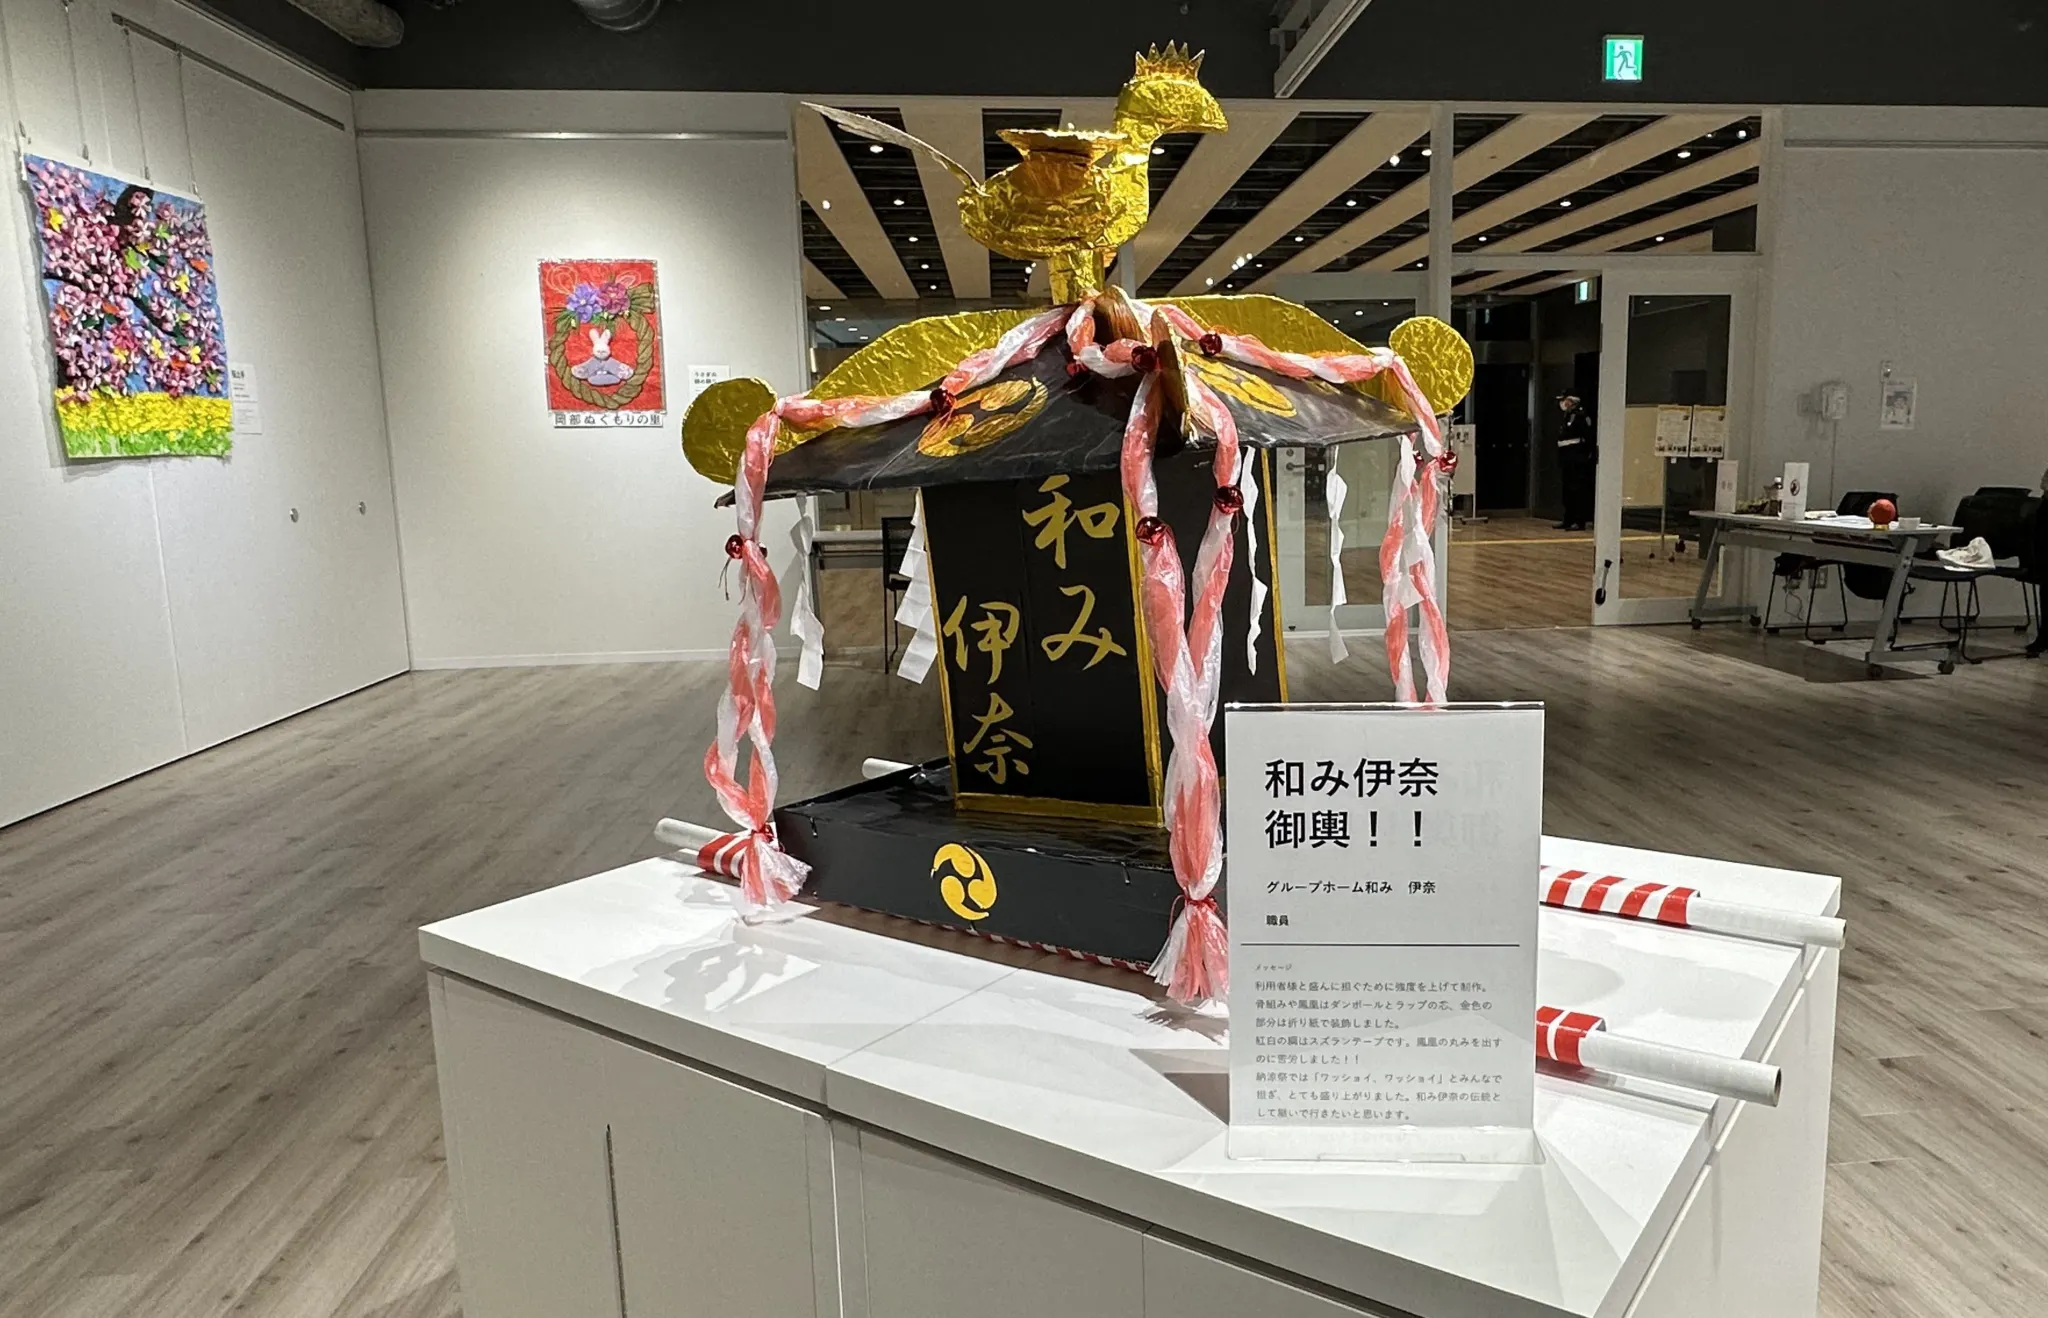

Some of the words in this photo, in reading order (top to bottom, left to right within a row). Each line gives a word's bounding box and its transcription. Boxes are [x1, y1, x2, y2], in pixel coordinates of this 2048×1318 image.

[555, 413, 660, 426] 岡部ぬくもりの里
[1022, 474, 1127, 671] 和み
[943, 595, 1034, 785] 伊奈
[1265, 757, 1439, 798] 和み伊奈
[1265, 809, 1423, 849] 御輿！！
[1267, 880, 1393, 894] グループホーム和み
[1408, 880, 1436, 894] 伊奈
[1266, 914, 1289, 926] 職員
[1255, 963, 1292, 971] メッセージ
